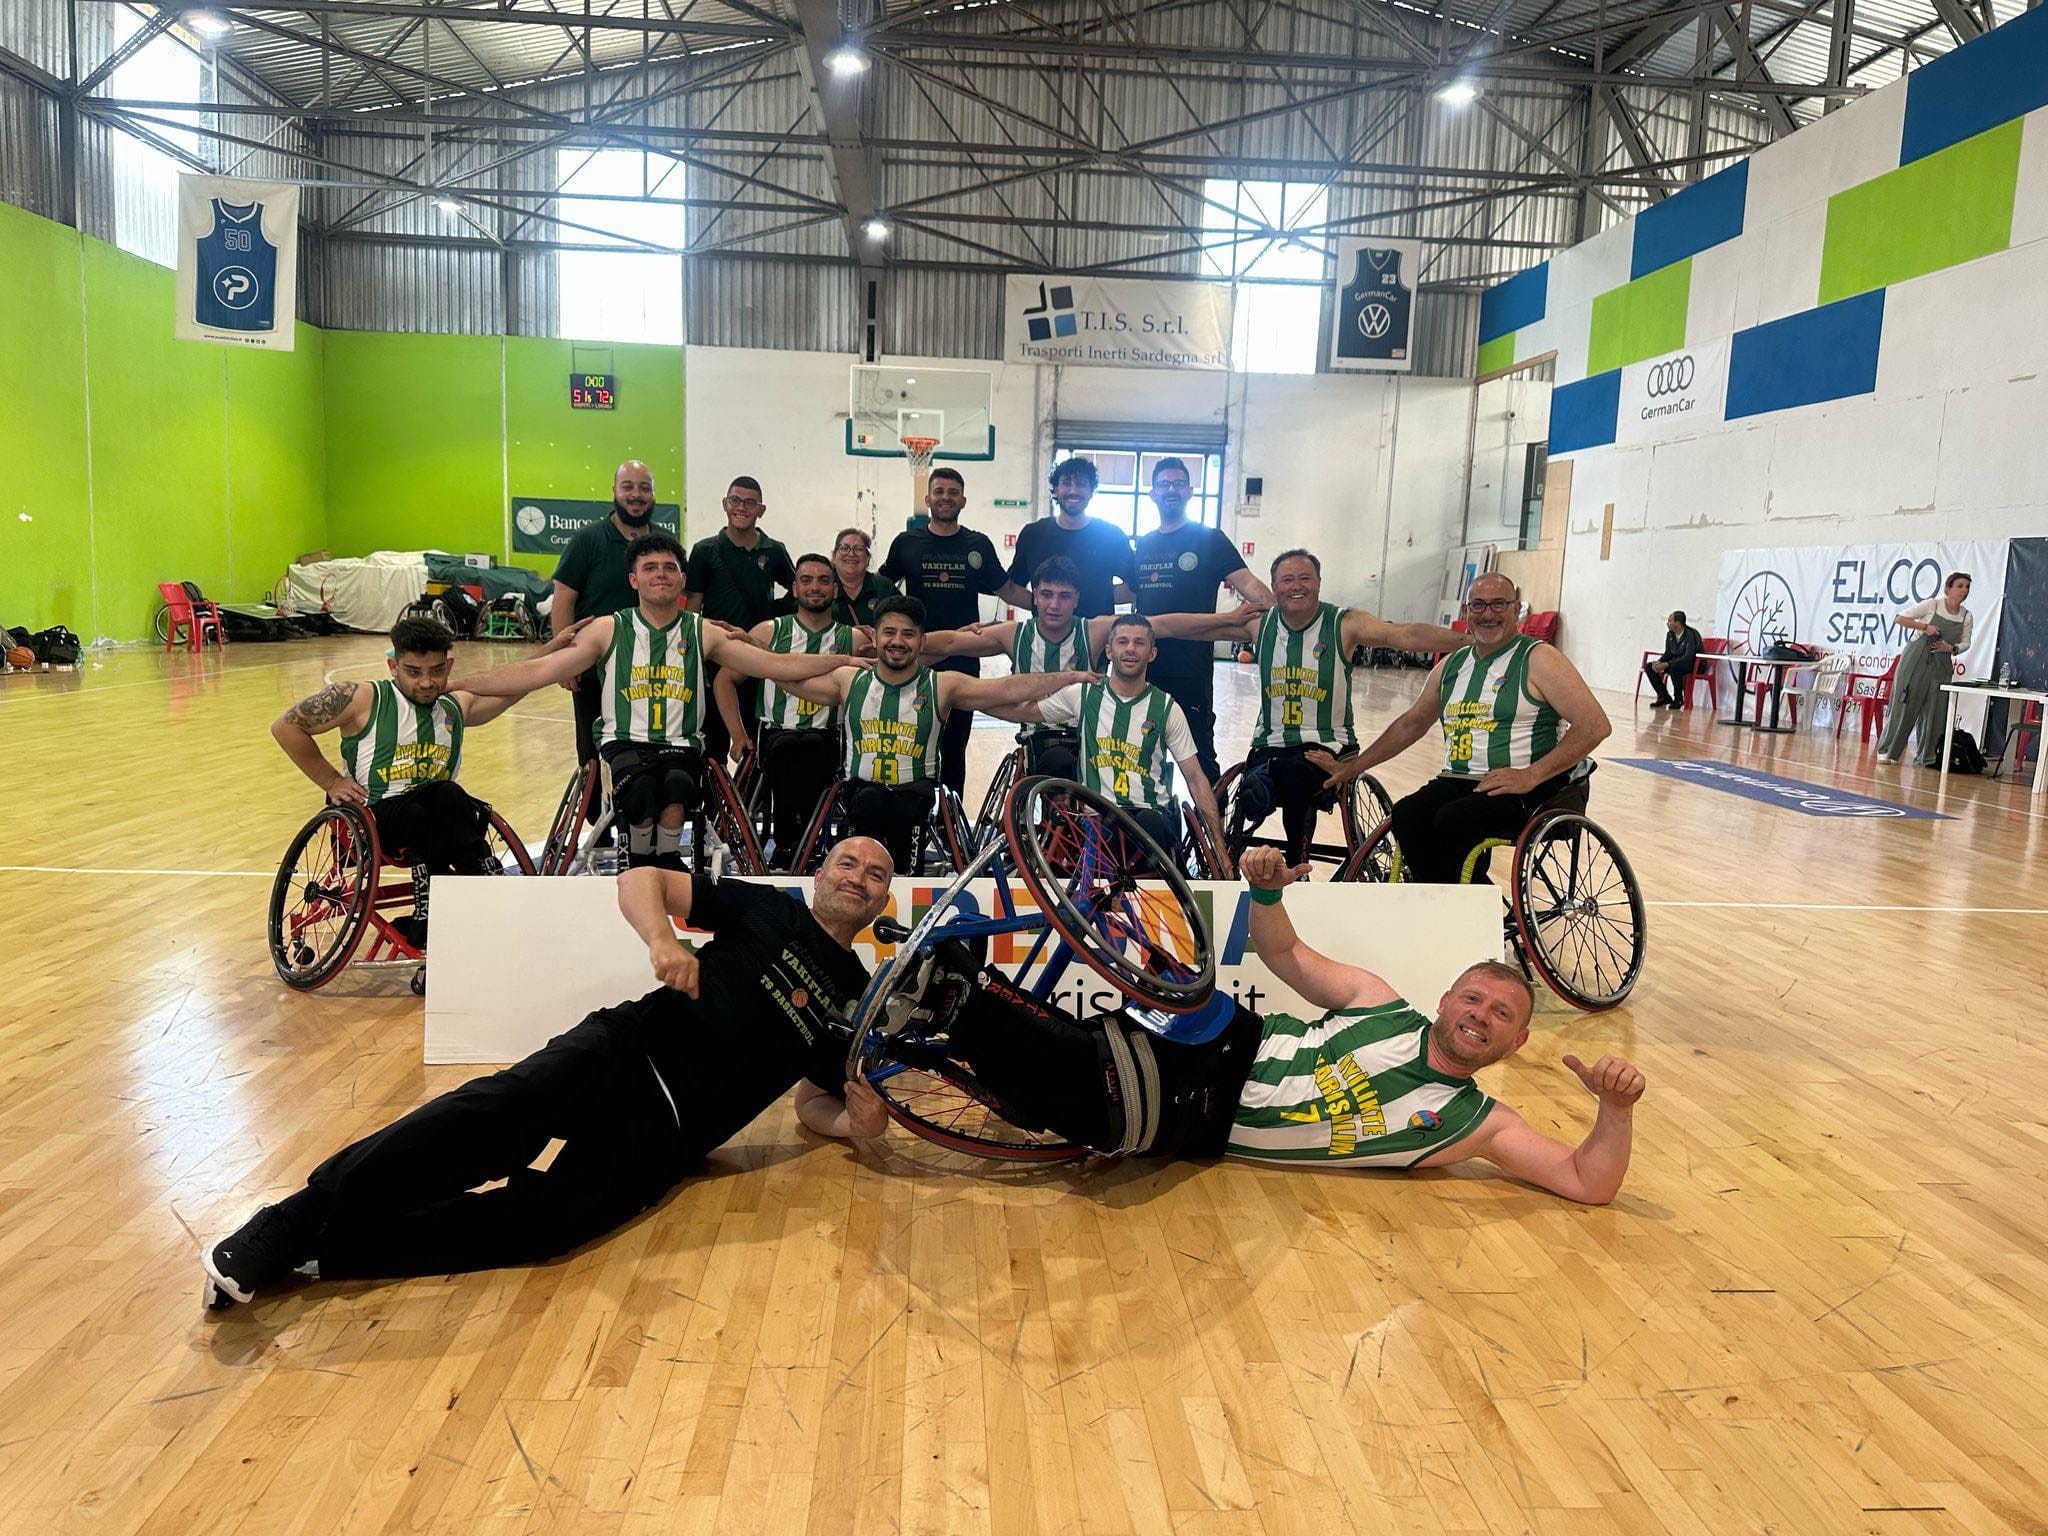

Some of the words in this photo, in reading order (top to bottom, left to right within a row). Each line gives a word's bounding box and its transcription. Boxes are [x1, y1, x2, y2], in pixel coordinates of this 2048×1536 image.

[225, 229, 251, 251] 50
[1382, 273, 1397, 284] 23
[1355, 289, 1398, 302] GermanCar
[1081, 311, 1132, 332] T.I.S.
[1142, 314, 1188, 335] S.r.l.
[1019, 342, 1083, 361] Trasporti
[1088, 345, 1126, 360] Inerti
[1130, 347, 1199, 365] Sardegna
[1203, 352, 1224, 364] srl
[1641, 398, 1696, 420] GermanCar
[1832, 558, 1942, 605] EL.CO
[631, 664, 684, 682] İYİLİKTE
[620, 682, 693, 703] YARIŞALIM
[652, 703, 663, 730] 1
[1282, 700, 1303, 726] 15
[872, 758, 899, 785] 13
[1113, 771, 1129, 797] 4
[1280, 1104, 1321, 1123] 7
